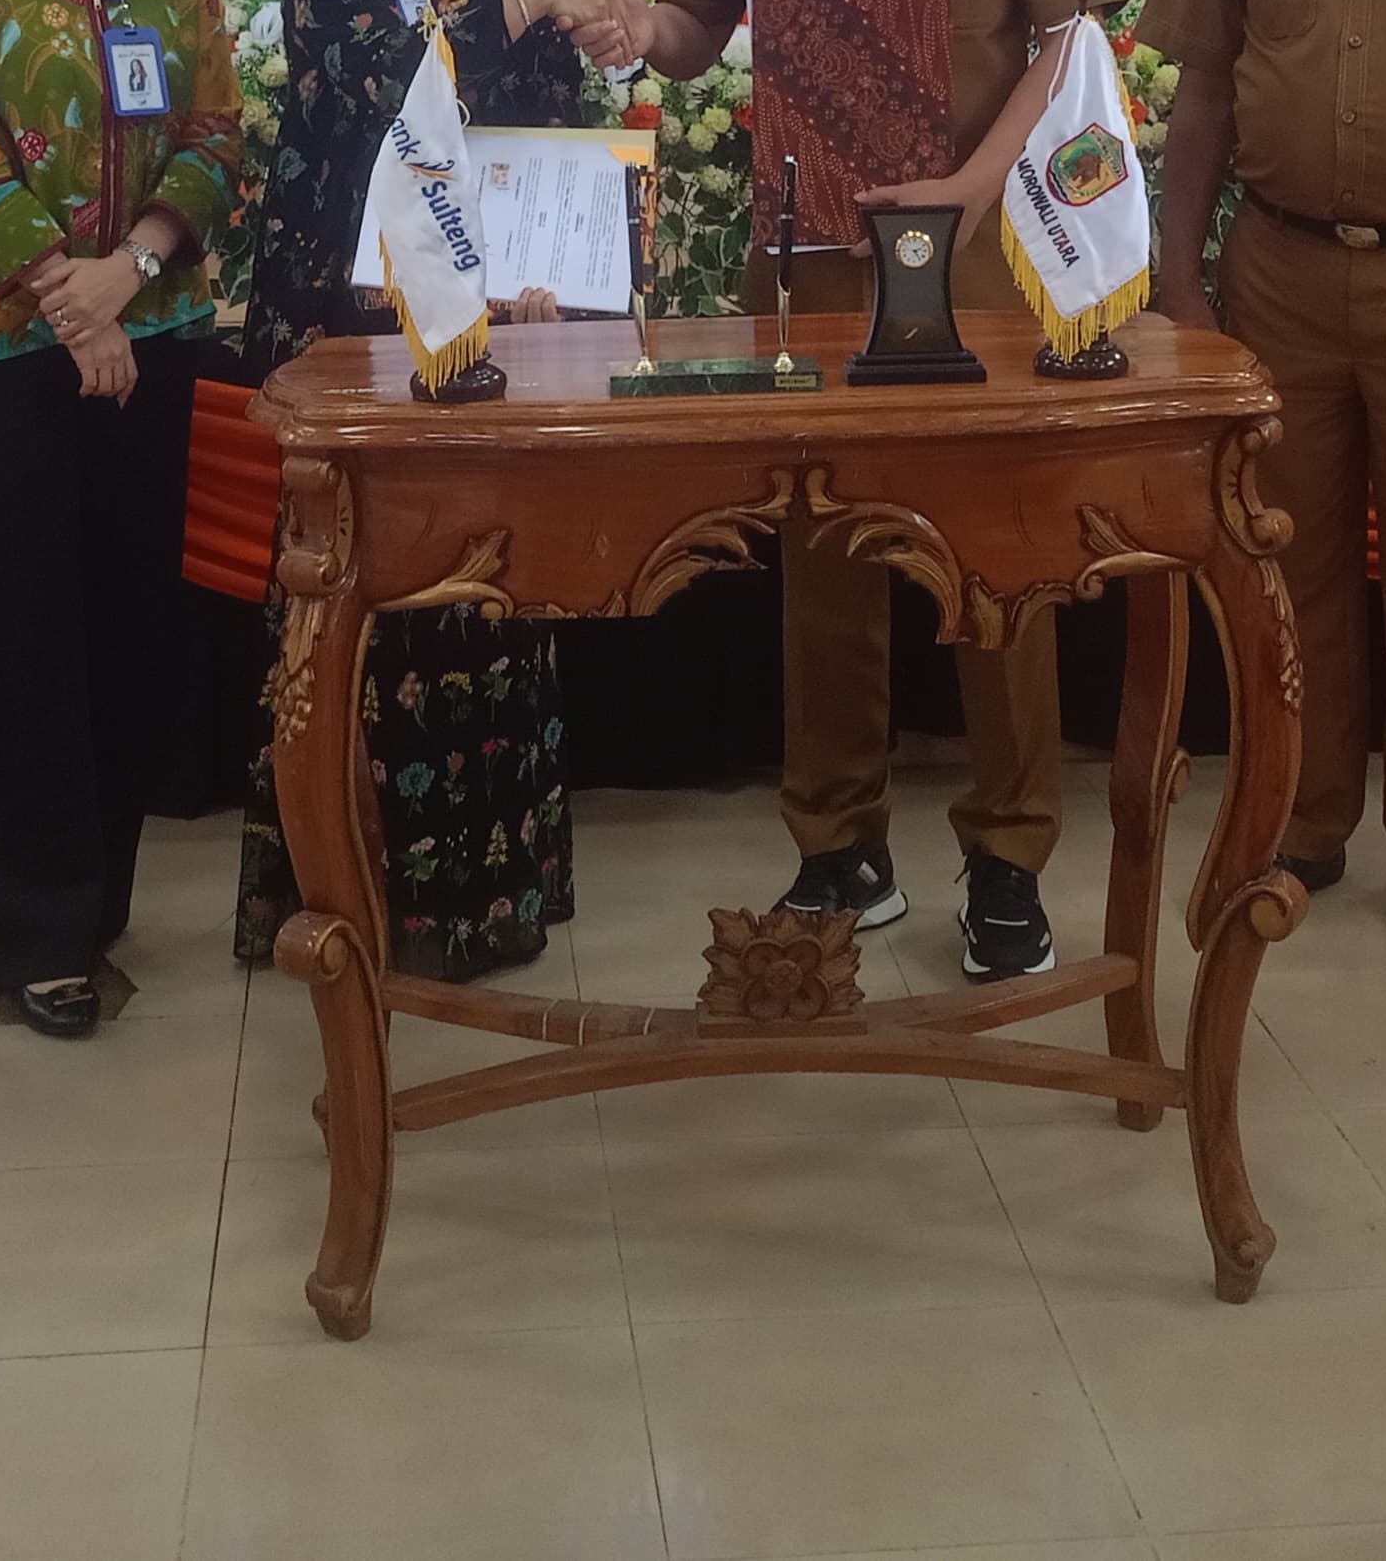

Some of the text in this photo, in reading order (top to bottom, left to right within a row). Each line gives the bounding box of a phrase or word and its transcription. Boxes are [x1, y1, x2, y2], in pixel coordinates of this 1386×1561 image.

[392, 118, 480, 272] ank Sulteng
[1017, 157, 1080, 269] MOROWALI UTARA
